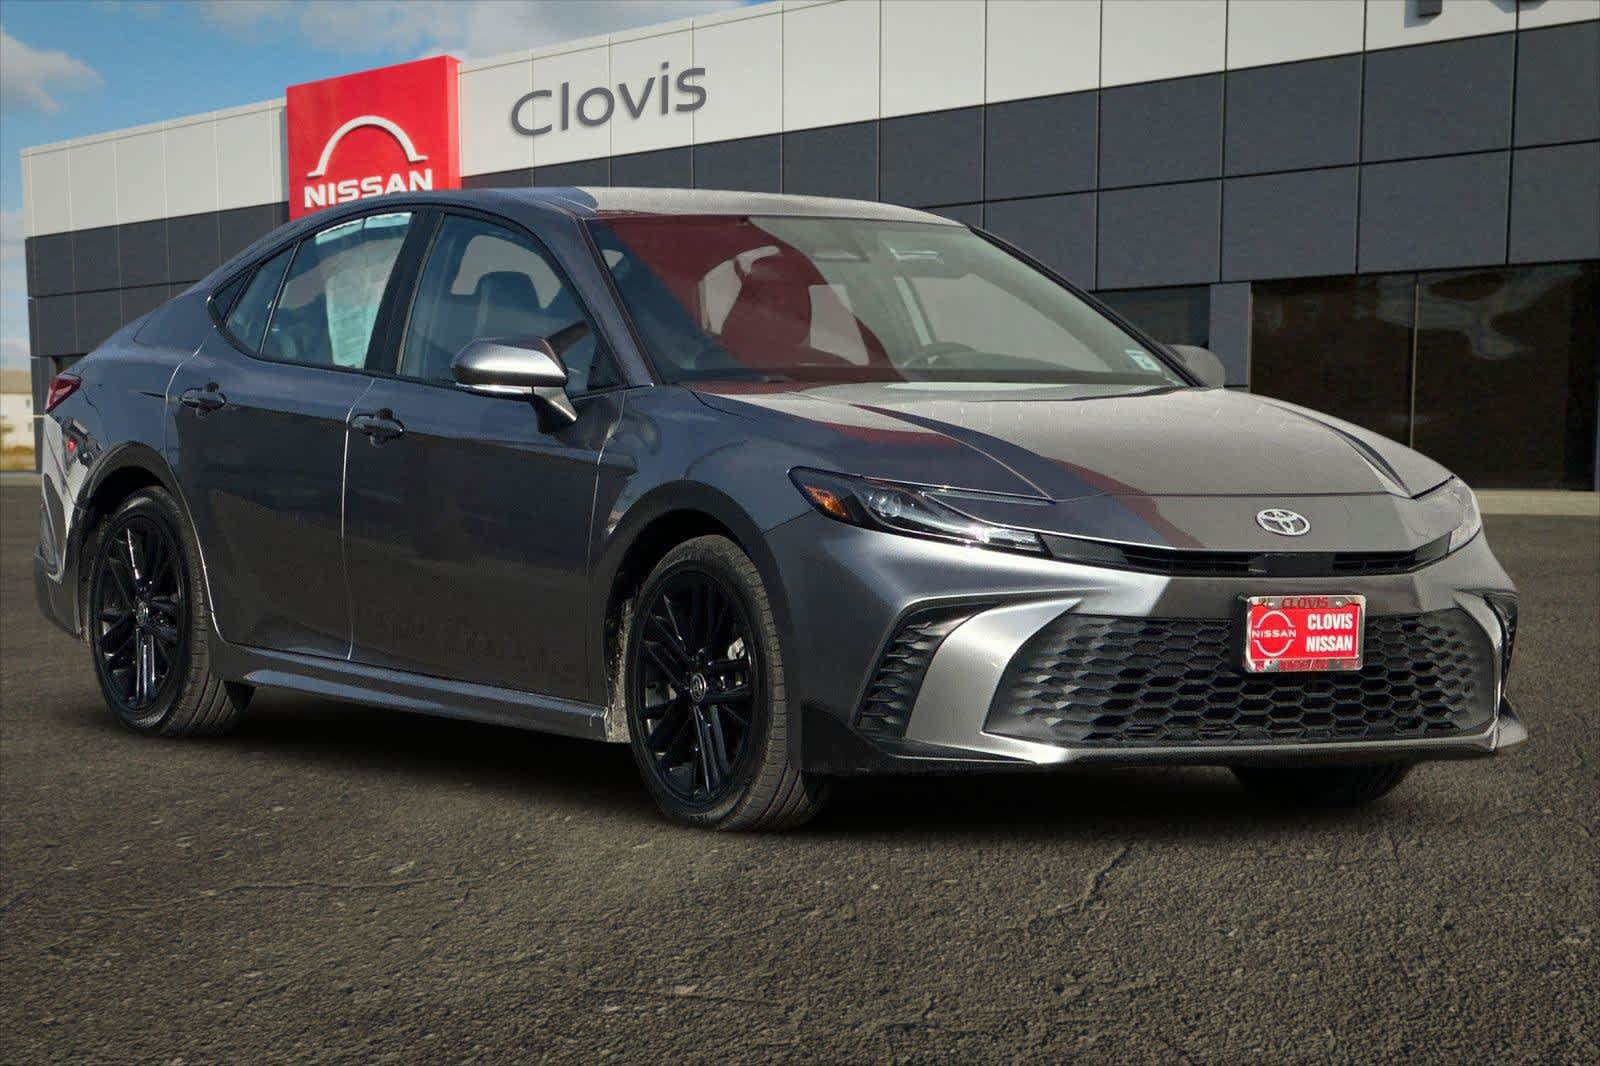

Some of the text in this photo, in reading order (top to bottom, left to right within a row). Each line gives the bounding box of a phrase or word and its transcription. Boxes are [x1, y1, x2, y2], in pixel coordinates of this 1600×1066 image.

[511, 61, 707, 136] Clovis
[303, 168, 433, 208] NISSAN
[1307, 613, 1353, 631] CLOVIS
[1251, 629, 1297, 638] NISSAN
[1305, 635, 1353, 653] NISSAN
